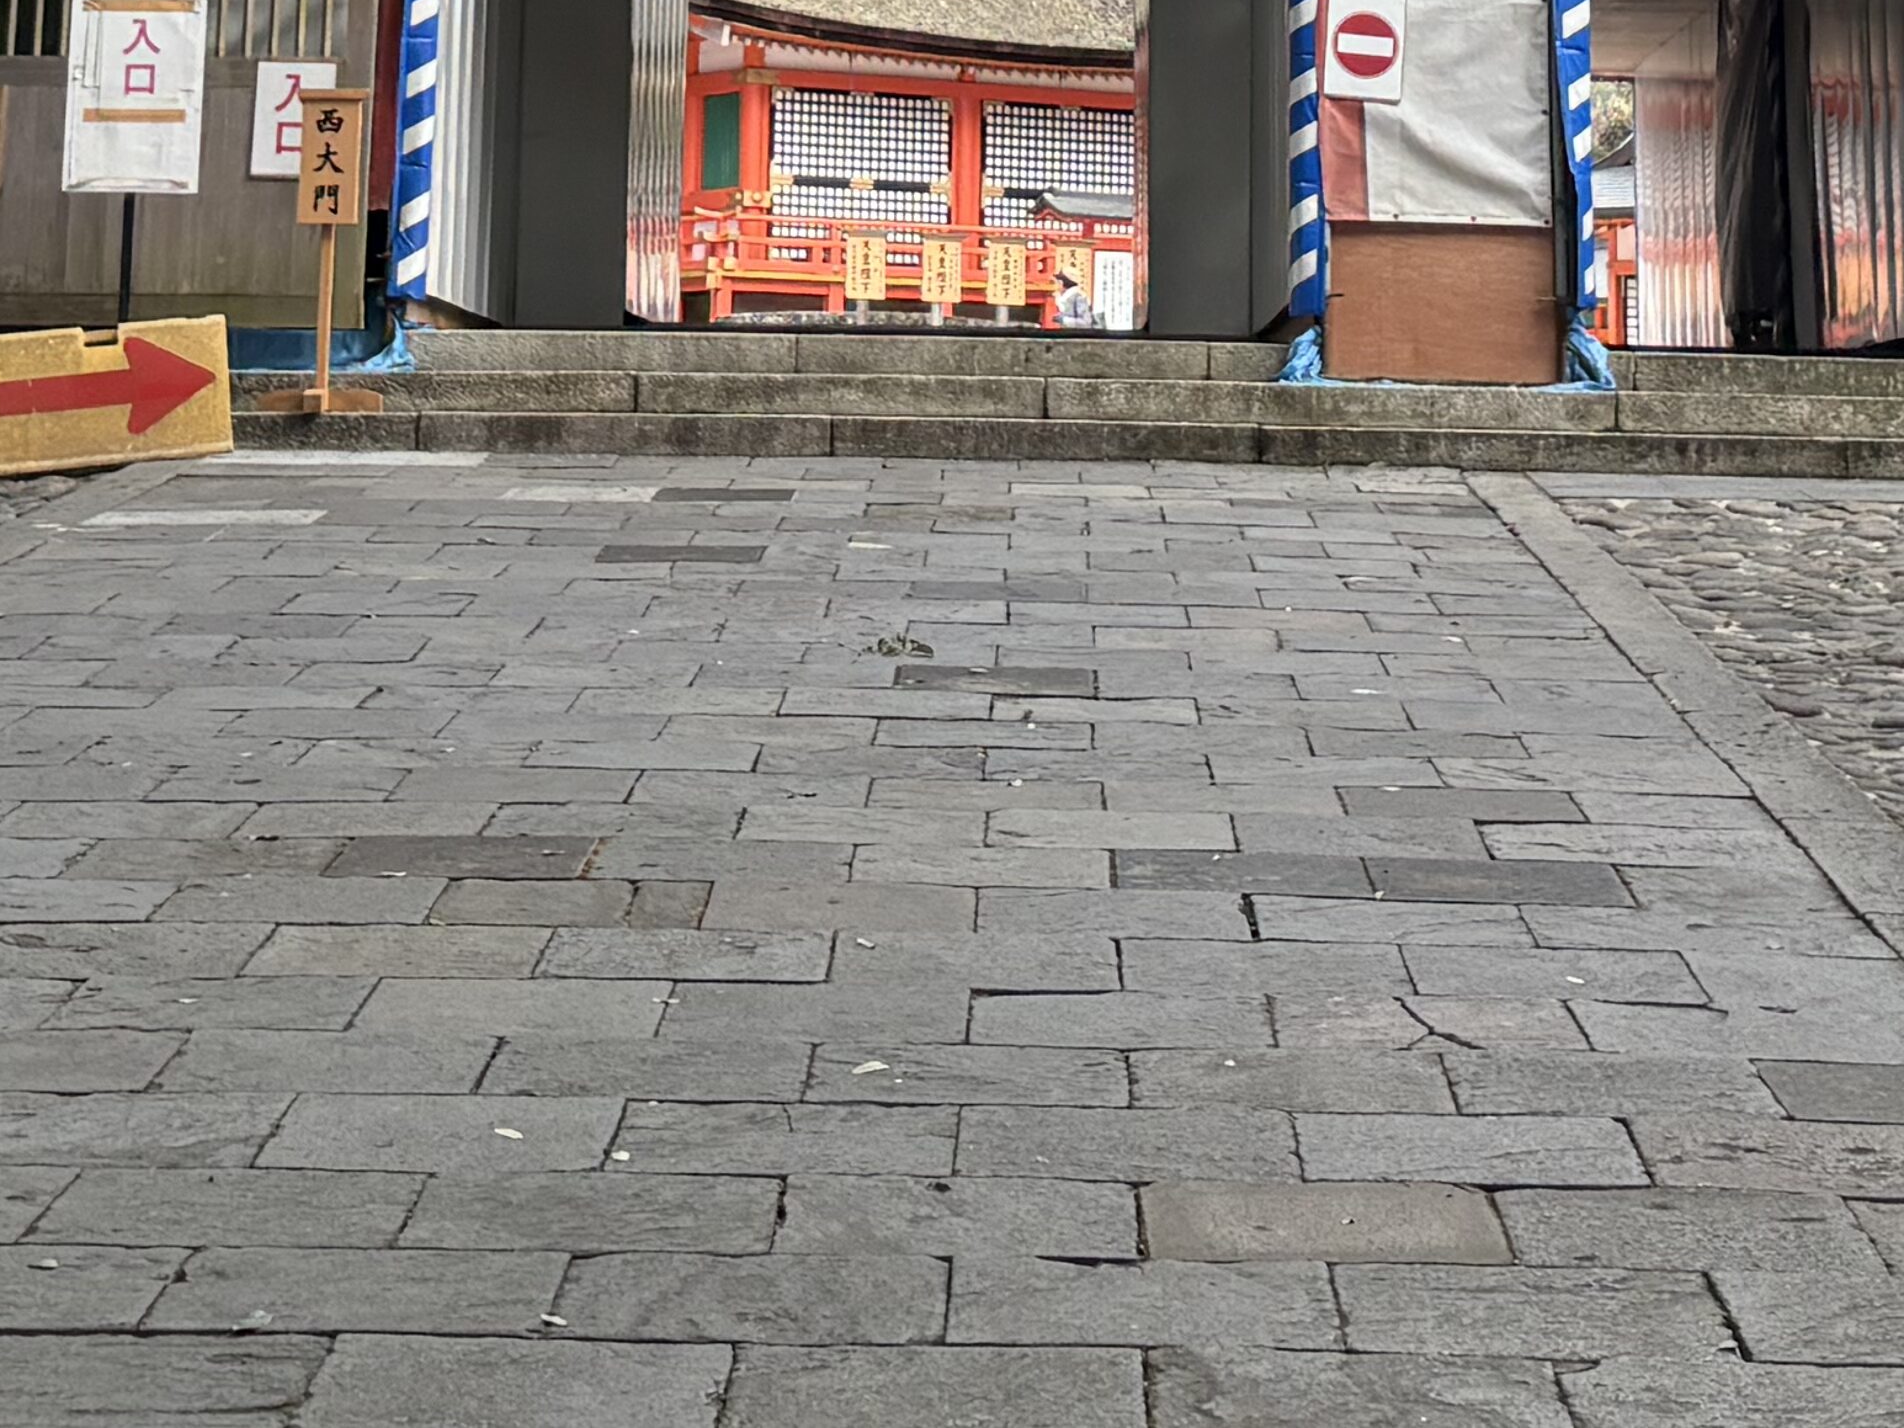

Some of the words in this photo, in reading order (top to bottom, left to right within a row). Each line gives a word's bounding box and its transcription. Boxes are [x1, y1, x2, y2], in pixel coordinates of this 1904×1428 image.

[123, 19, 161, 95] 入口
[313, 108, 345, 215] 西大門
